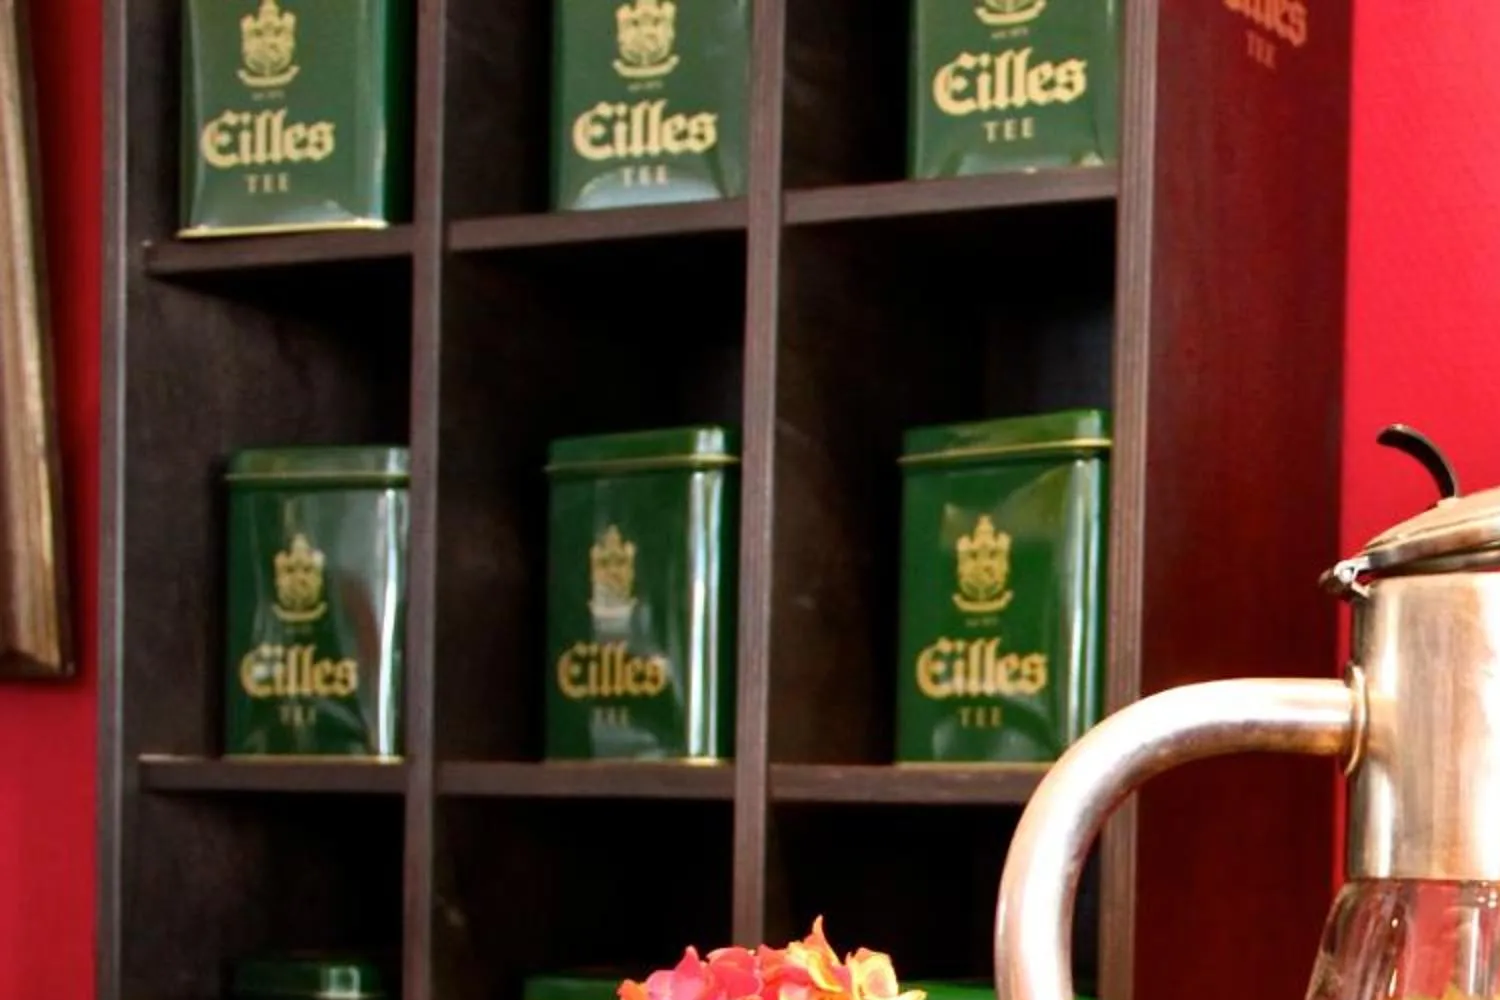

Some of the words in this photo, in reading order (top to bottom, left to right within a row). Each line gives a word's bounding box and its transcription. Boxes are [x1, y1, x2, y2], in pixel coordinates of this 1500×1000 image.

[933, 47, 1087, 115] Eilles
[201, 107, 335, 168] Eilles
[573, 99, 718, 161] Eilles
[983, 116, 1034, 142] TEE
[241, 644, 357, 698] Eilles
[558, 642, 666, 698] Eilles
[917, 638, 1047, 698] Eilles
